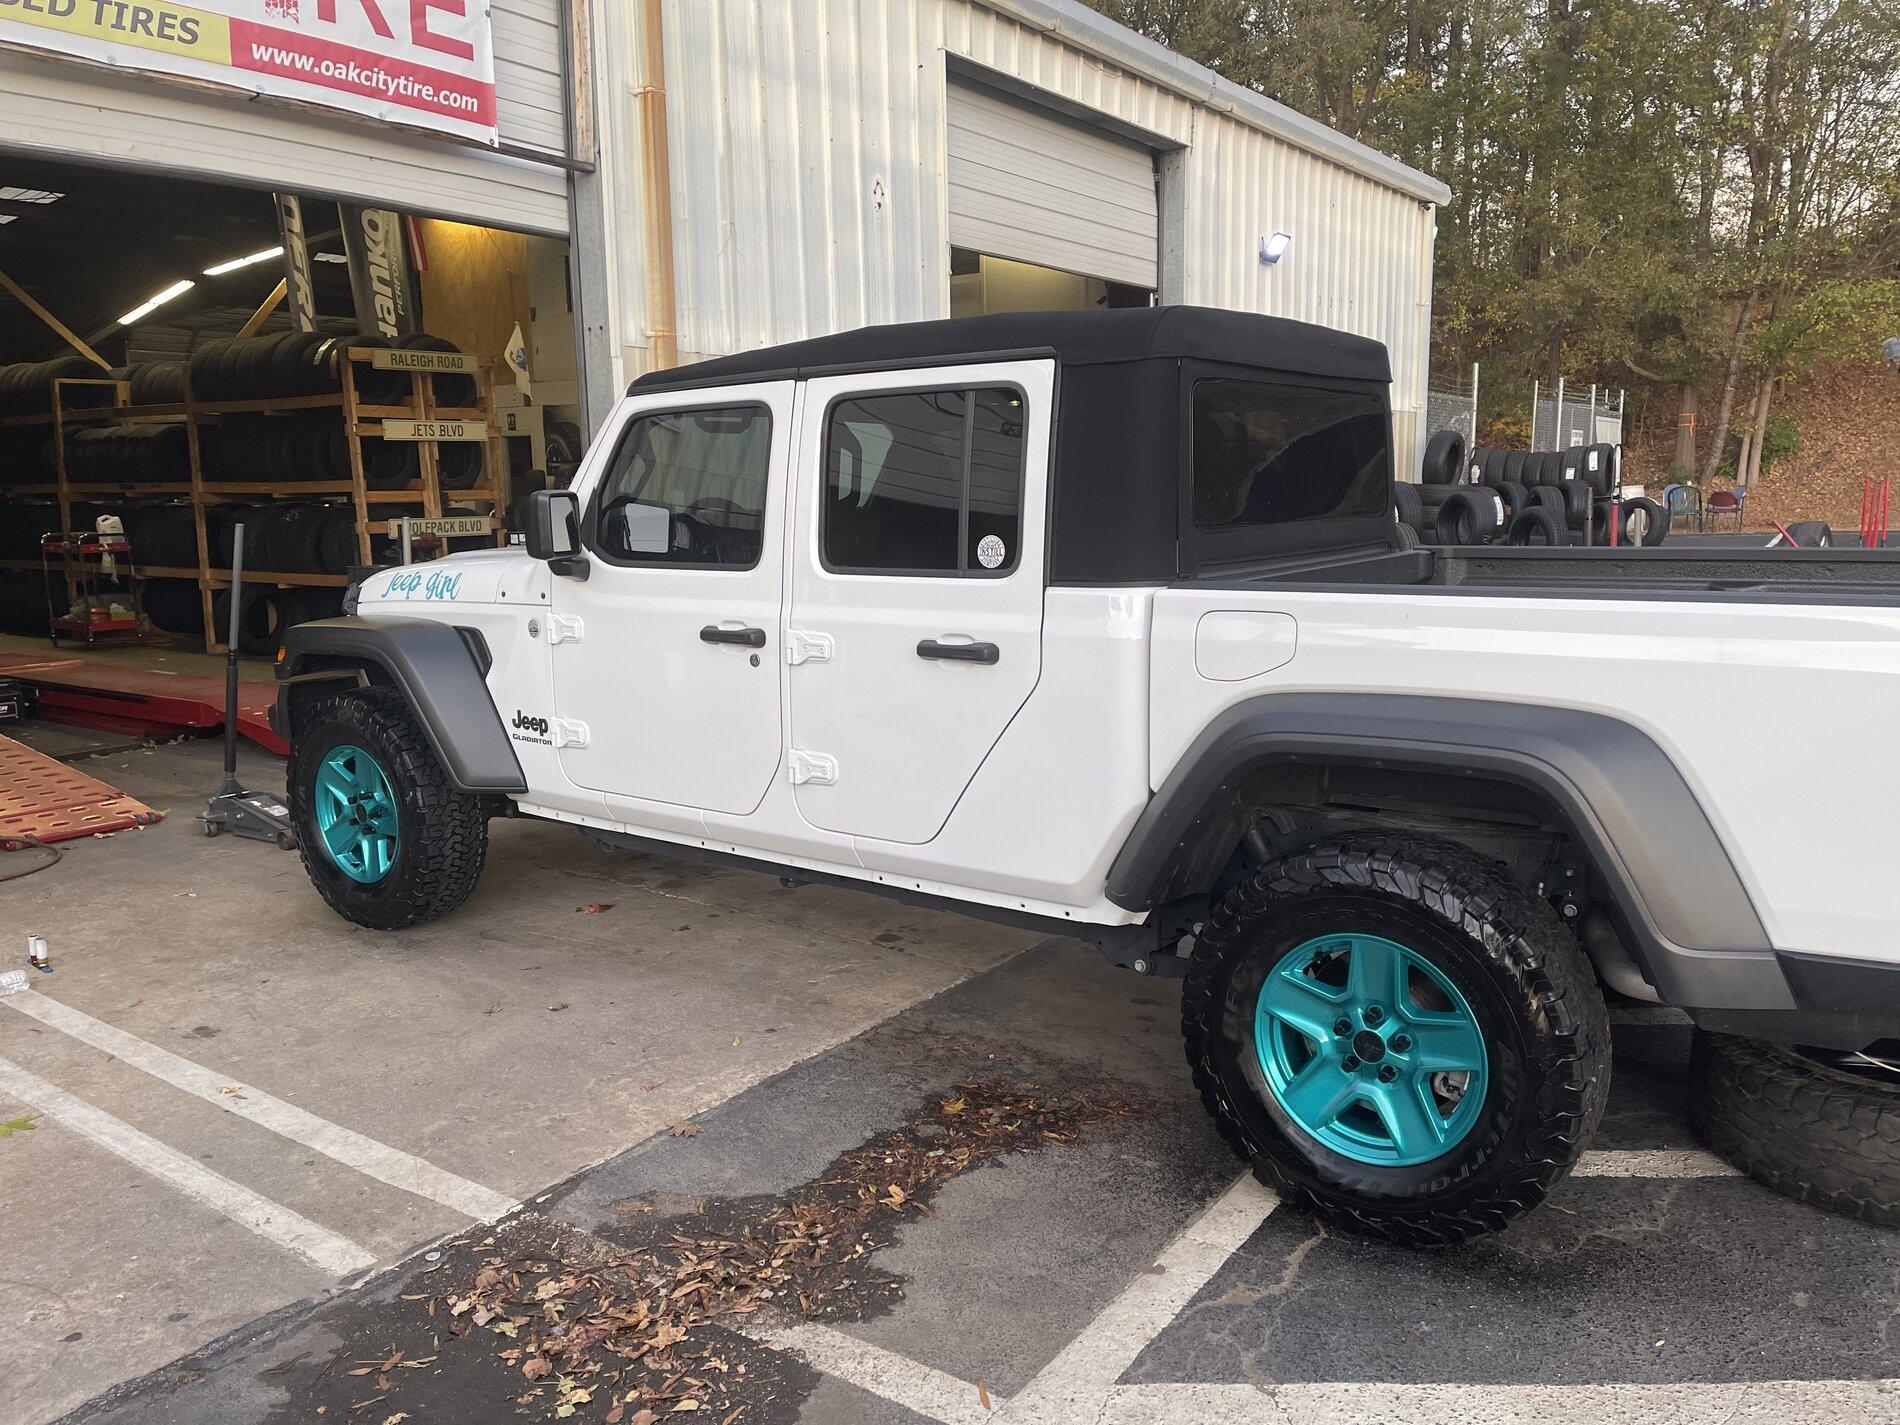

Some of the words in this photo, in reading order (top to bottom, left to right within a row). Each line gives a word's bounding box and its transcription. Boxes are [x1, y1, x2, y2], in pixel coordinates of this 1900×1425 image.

[89, 0, 201, 46] TIRES
[251, 43, 479, 112] www.oakcitytire.com
[390, 353, 434, 368] RALEIGH
[437, 356, 464, 369] ROAD
[411, 424, 435, 437] JETS
[439, 425, 464, 437] BLVD
[408, 521, 456, 535] OLFPACK
[458, 520, 482, 532] BLVD
[512, 709, 549, 737] Jeep
[512, 733, 553, 746] GLADIATOR
